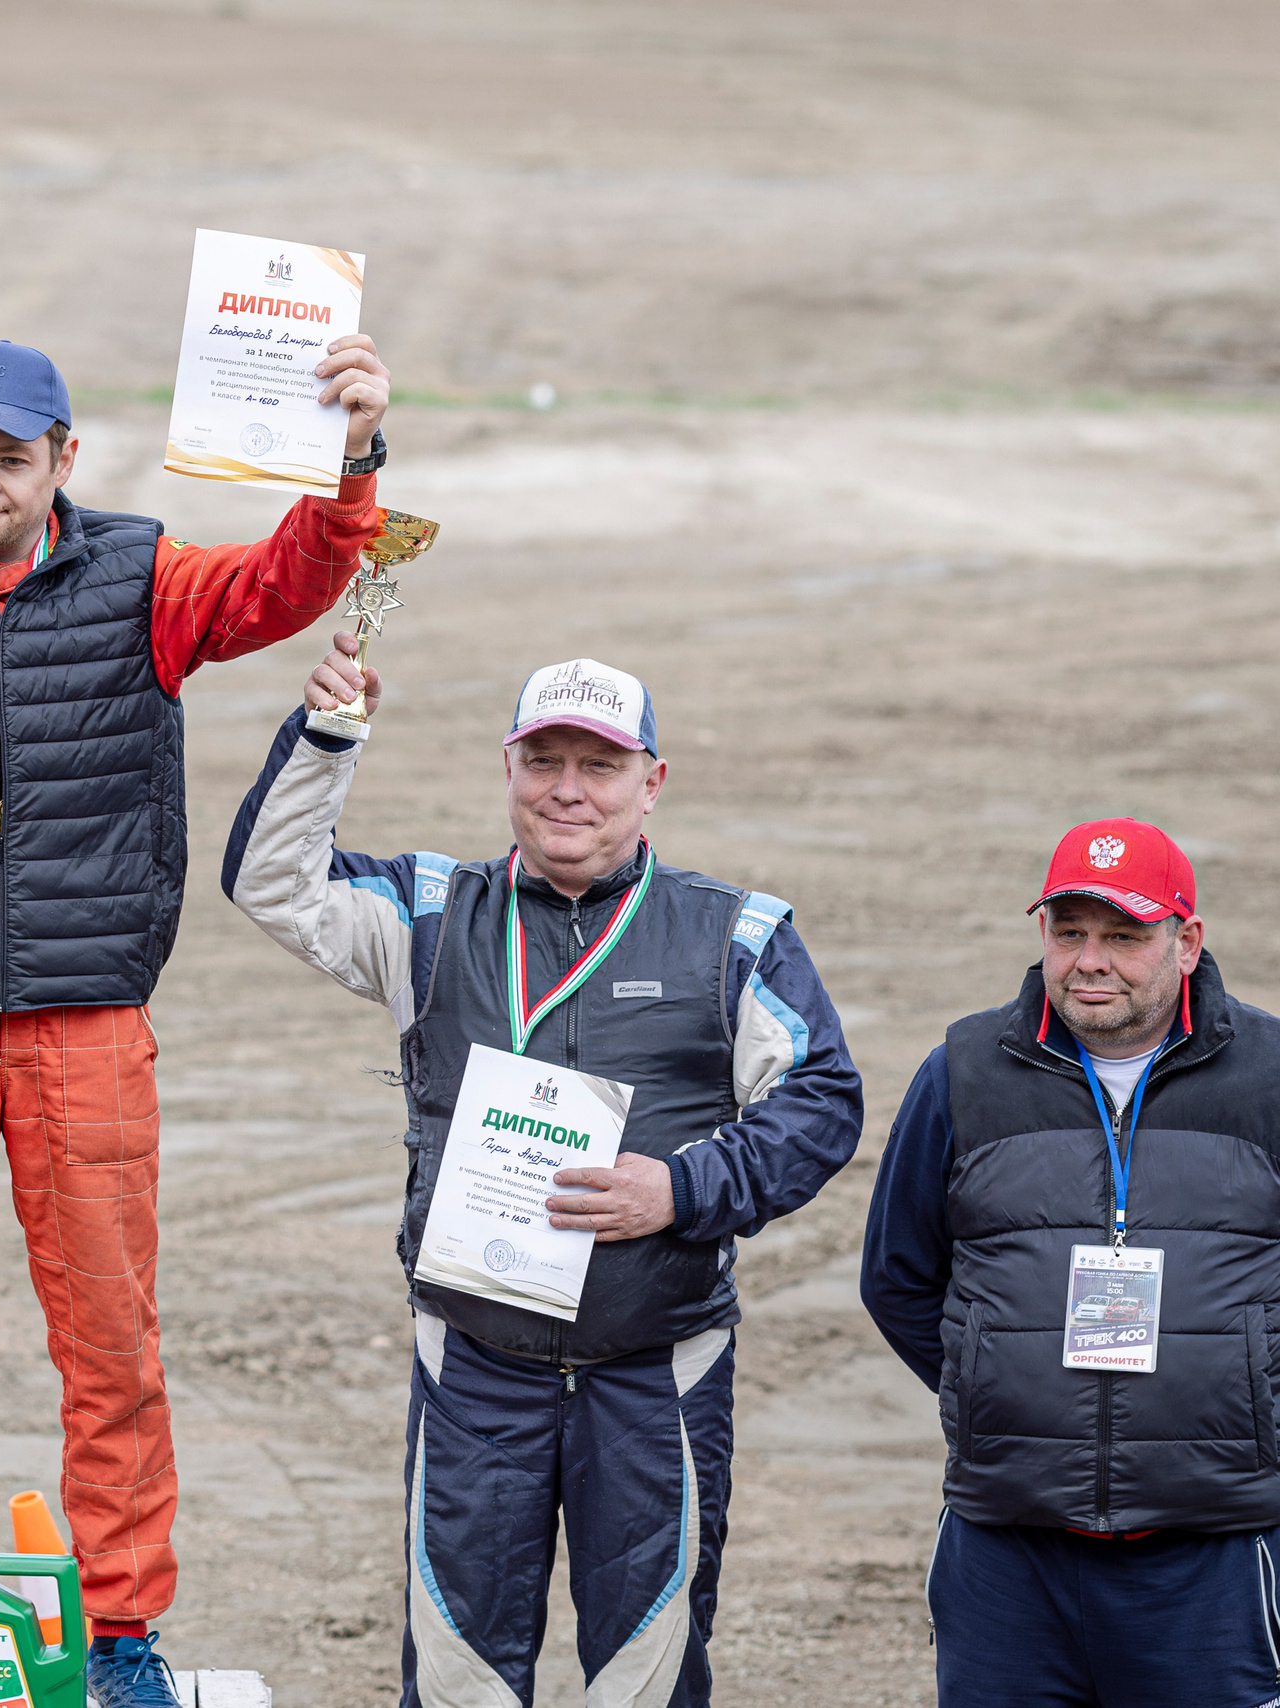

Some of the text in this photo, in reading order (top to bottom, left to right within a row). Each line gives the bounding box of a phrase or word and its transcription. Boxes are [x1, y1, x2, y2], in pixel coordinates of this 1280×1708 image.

[218, 291, 331, 325] ДИПЛОМ
[209, 324, 323, 349] Белобородов Дмитрий
[245, 348, 293, 361] за 1 место
[205, 356, 248, 368] чемпионате
[250, 361, 306, 375] Новосибирской
[228, 370, 289, 386] автомобильному
[290, 379, 314, 389] спорту
[216, 381, 260, 392] дисциплине
[262, 387, 295, 398] трековые
[297, 392, 317, 401] гонки
[217, 392, 241, 401] классе
[537, 686, 625, 713] Bangkok
[590, 704, 619, 720] Thailand
[421, 885, 448, 901] OM
[735, 920, 764, 938] MP
[481, 1107, 591, 1152] ДИПЛОМ
[517, 1147, 563, 1167] Андрей
[464, 1167, 504, 1183] чемпионате
[504, 1178, 557, 1196] Новосибирской
[502, 1164, 547, 1182] за 3 место
[482, 1184, 540, 1206] автомобильному
[471, 1193, 512, 1209] дисциплине
[513, 1205, 545, 1218] трековые
[471, 1205, 493, 1216] классе
[1074, 1328, 1147, 1347] ТРЕК 400
[1072, 1354, 1146, 1366] ОРГКОМИТЕТ
